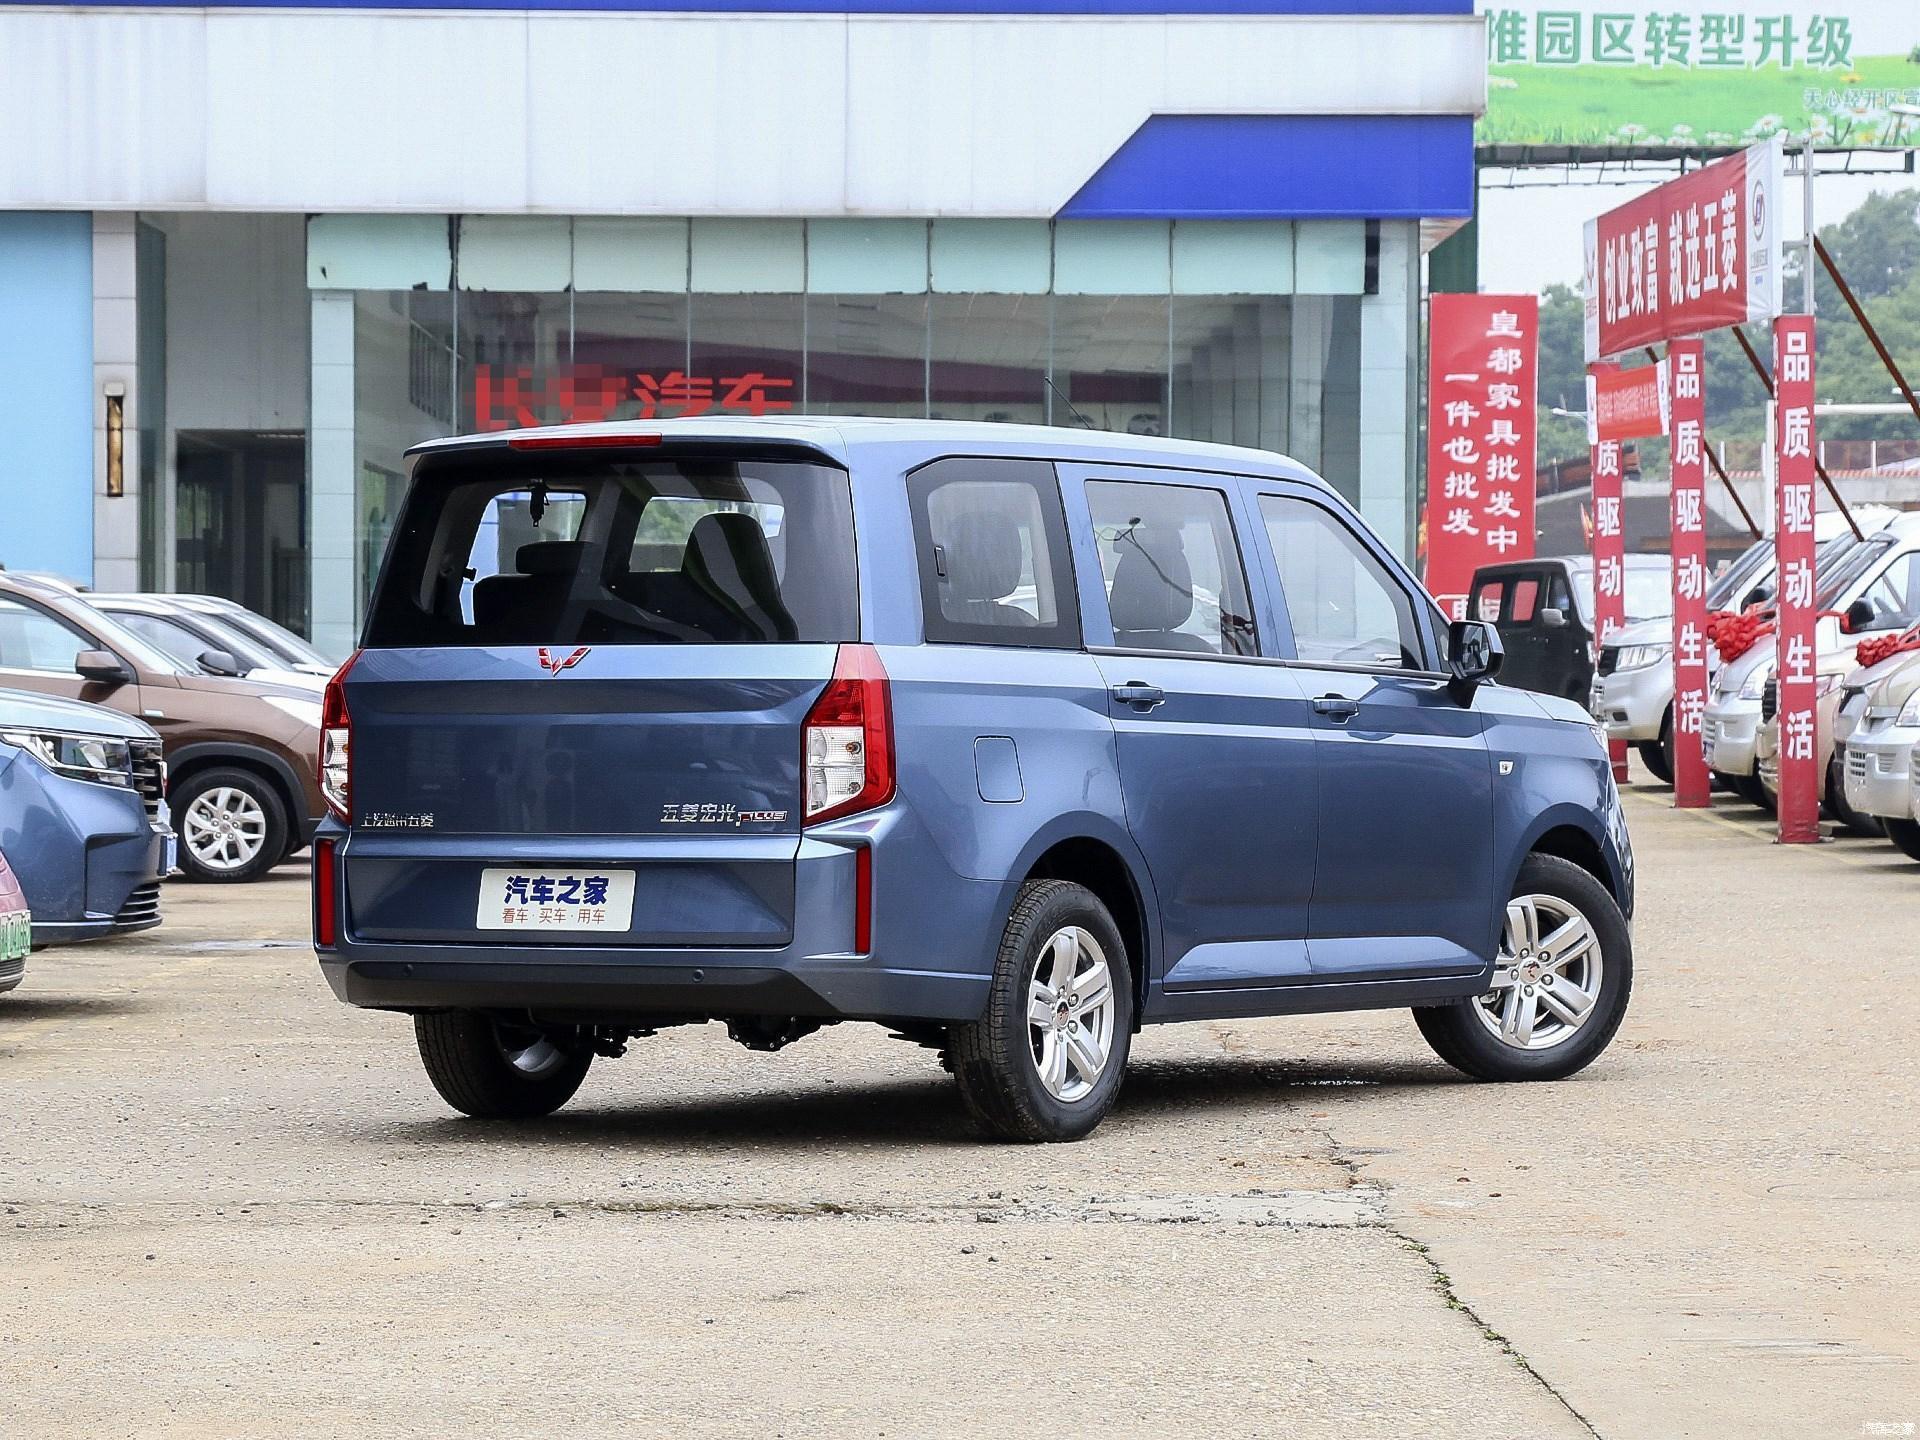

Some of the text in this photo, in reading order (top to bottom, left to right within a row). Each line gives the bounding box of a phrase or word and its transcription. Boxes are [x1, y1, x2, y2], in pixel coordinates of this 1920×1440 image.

[1441, 372, 1480, 536] 一件也批发
[1483, 309, 1523, 553] 皇都家具批发中
[1674, 353, 1705, 734] 品质驱动生活
[1783, 331, 1815, 760] 品质驱动生活
[503, 875, 610, 906] 汽车之家
